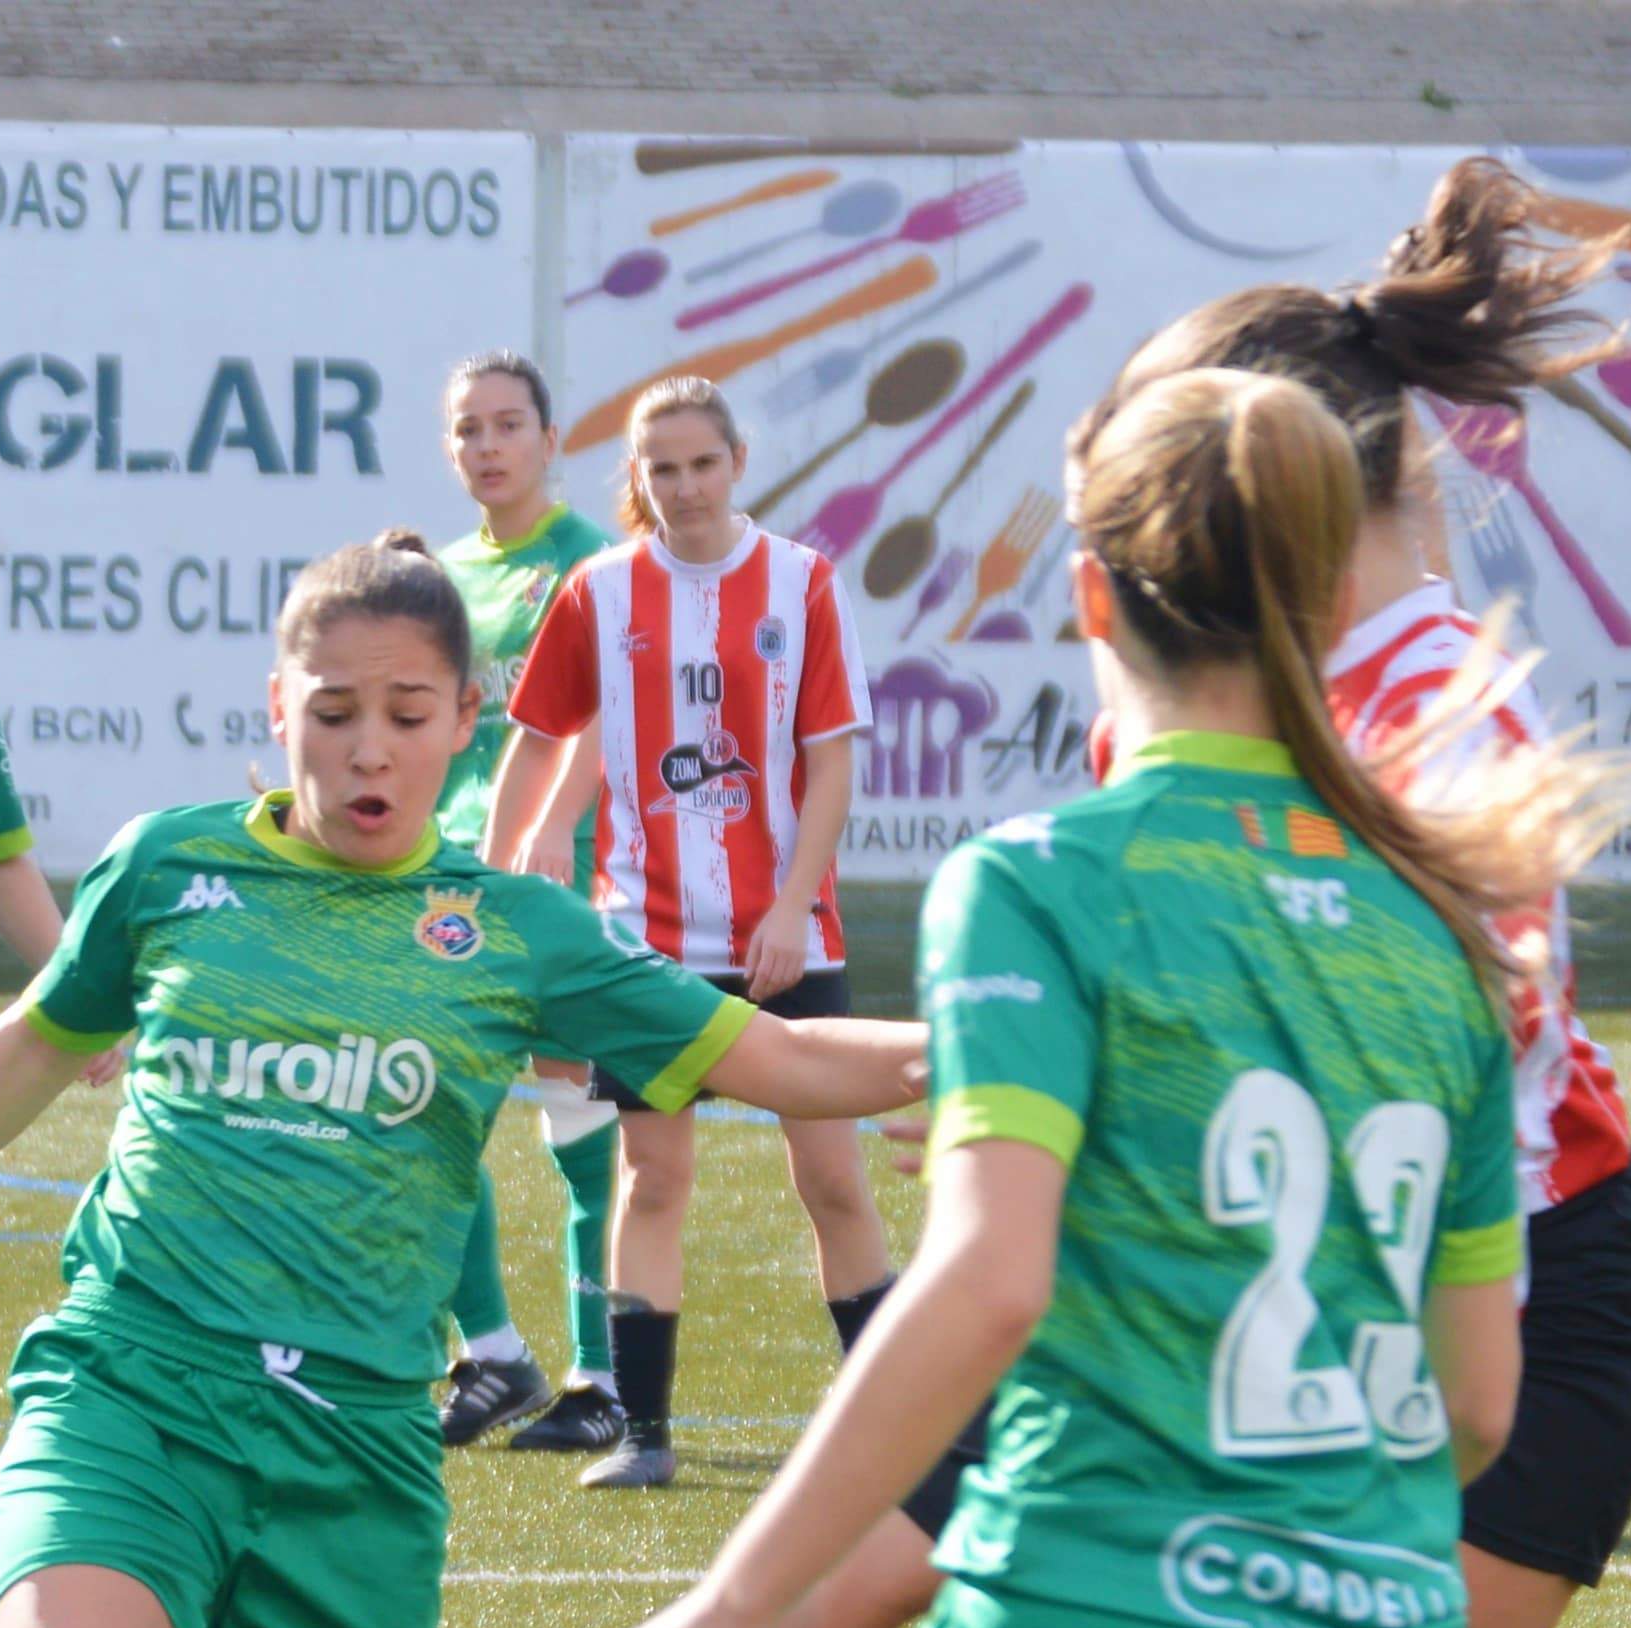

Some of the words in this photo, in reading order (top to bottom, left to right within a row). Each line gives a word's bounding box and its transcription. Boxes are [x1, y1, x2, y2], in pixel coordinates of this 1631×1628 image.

[106, 162, 143, 232] Y
[161, 163, 501, 240] EMBUTIDOS
[680, 662, 723, 706] 10
[670, 757, 703, 781] ZONA
[165, 1033, 377, 1113] nuroil
[223, 1111, 350, 1142] www.nuroil.cat
[1203, 1066, 1451, 1462] 22
